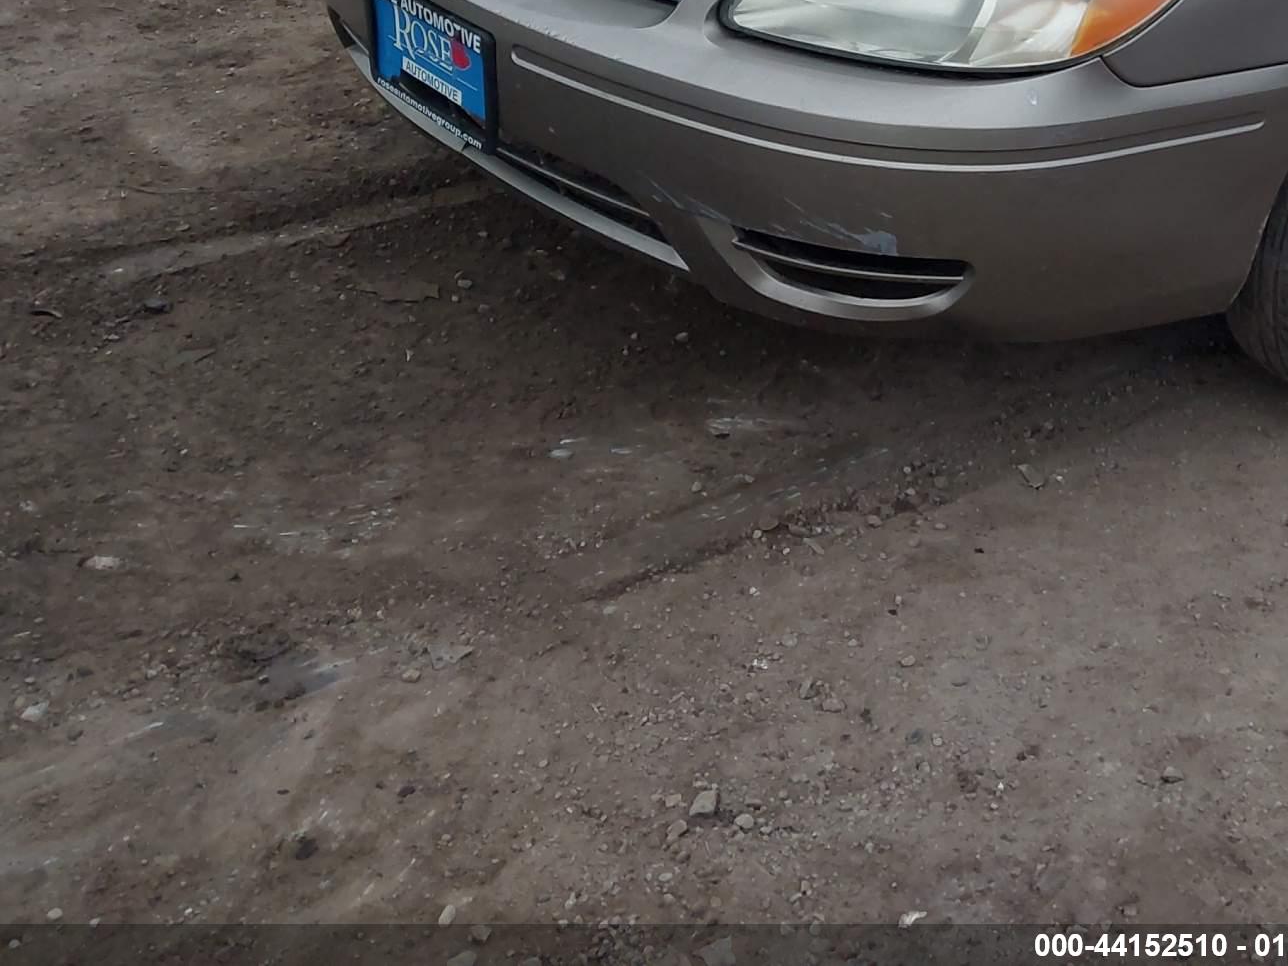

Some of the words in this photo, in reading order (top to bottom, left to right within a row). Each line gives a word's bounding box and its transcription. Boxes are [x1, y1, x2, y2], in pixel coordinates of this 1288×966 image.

[393, 4, 453, 70] ROSE
[377, 77, 482, 149] roseautomotivegroup.com
[405, 61, 460, 101] AUTOMOTIVE
